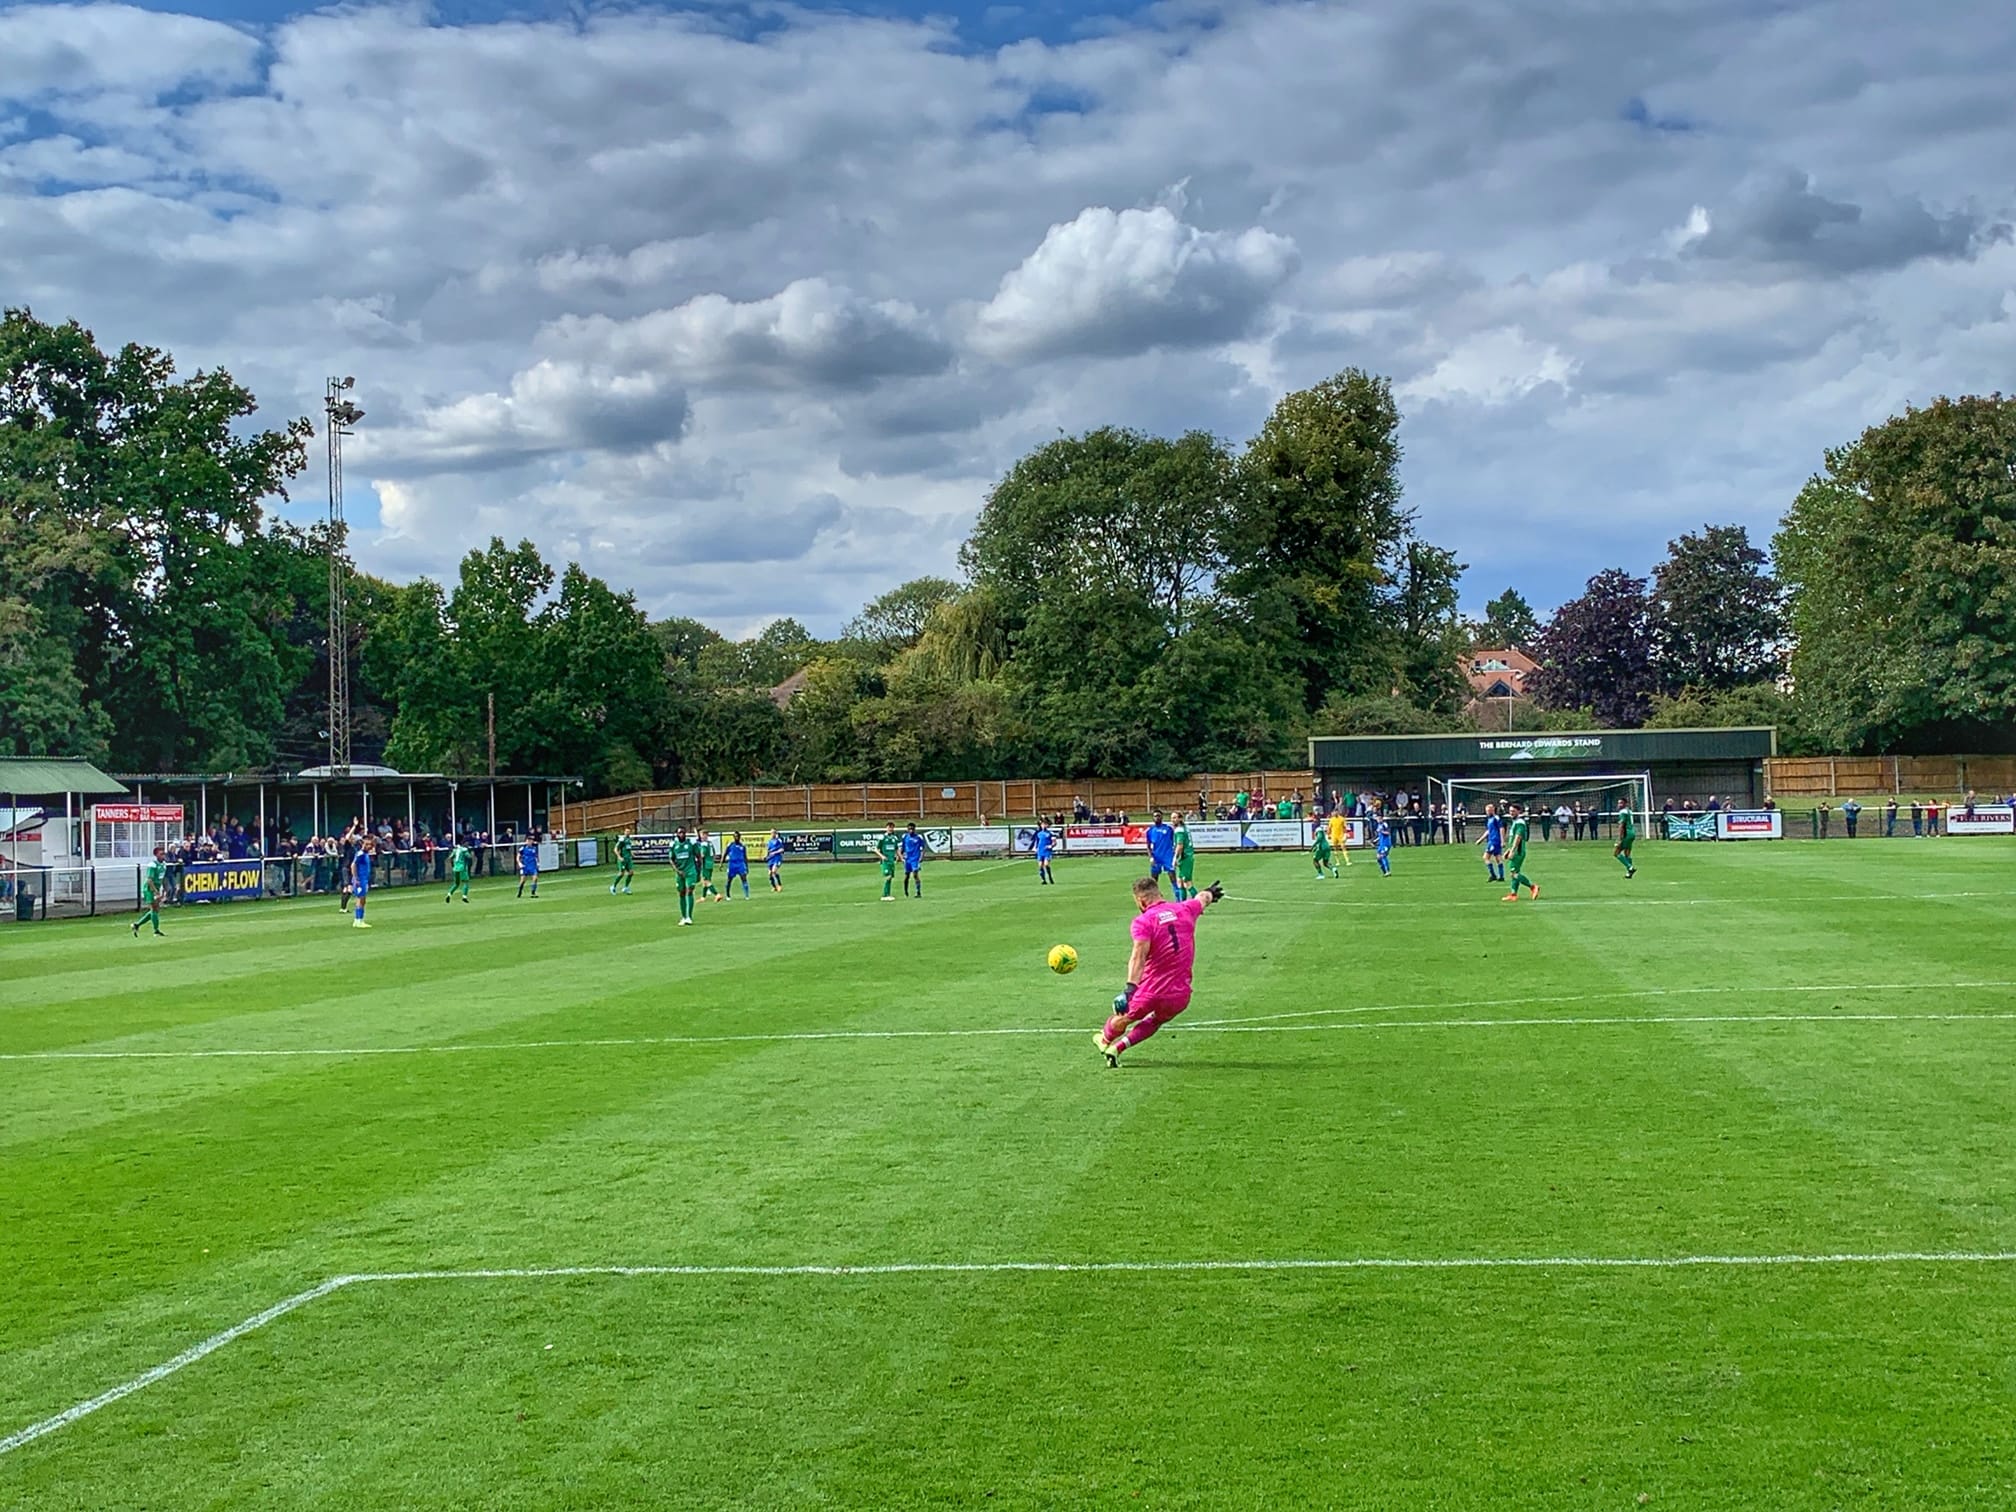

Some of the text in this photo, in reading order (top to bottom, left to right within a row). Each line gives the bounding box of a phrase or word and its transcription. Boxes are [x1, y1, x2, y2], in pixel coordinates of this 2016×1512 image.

[1534, 739, 1572, 747] EDWARDS
[97, 808, 129, 819] TANNERS
[228, 869, 260, 890] FLOW
[1167, 923, 1180, 953] 1
